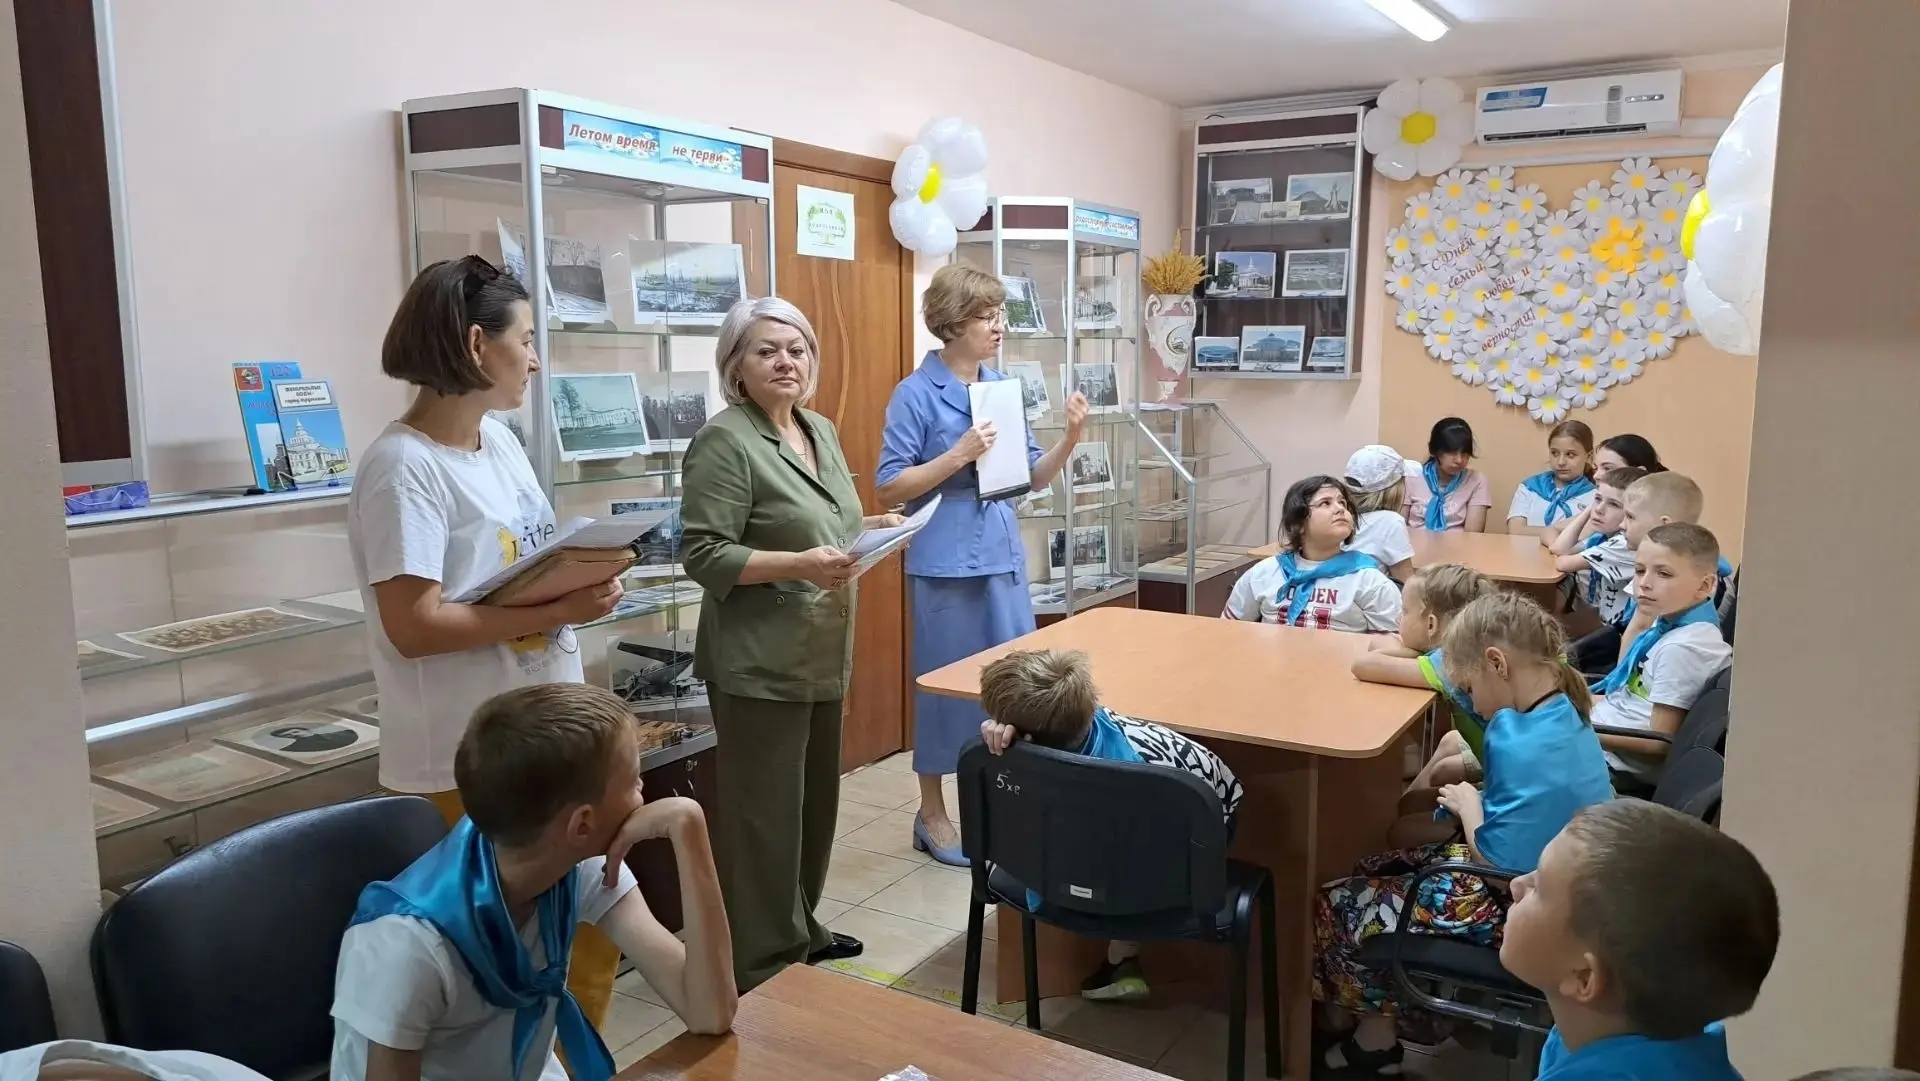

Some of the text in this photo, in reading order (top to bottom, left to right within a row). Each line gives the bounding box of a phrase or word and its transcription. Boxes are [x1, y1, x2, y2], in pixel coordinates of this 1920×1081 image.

[568, 123, 613, 143] Летом
[616, 133, 657, 152] время
[672, 145, 687, 156] не
[1431, 237, 1476, 271] С Днём
[1481, 266, 1530, 303] любви и
